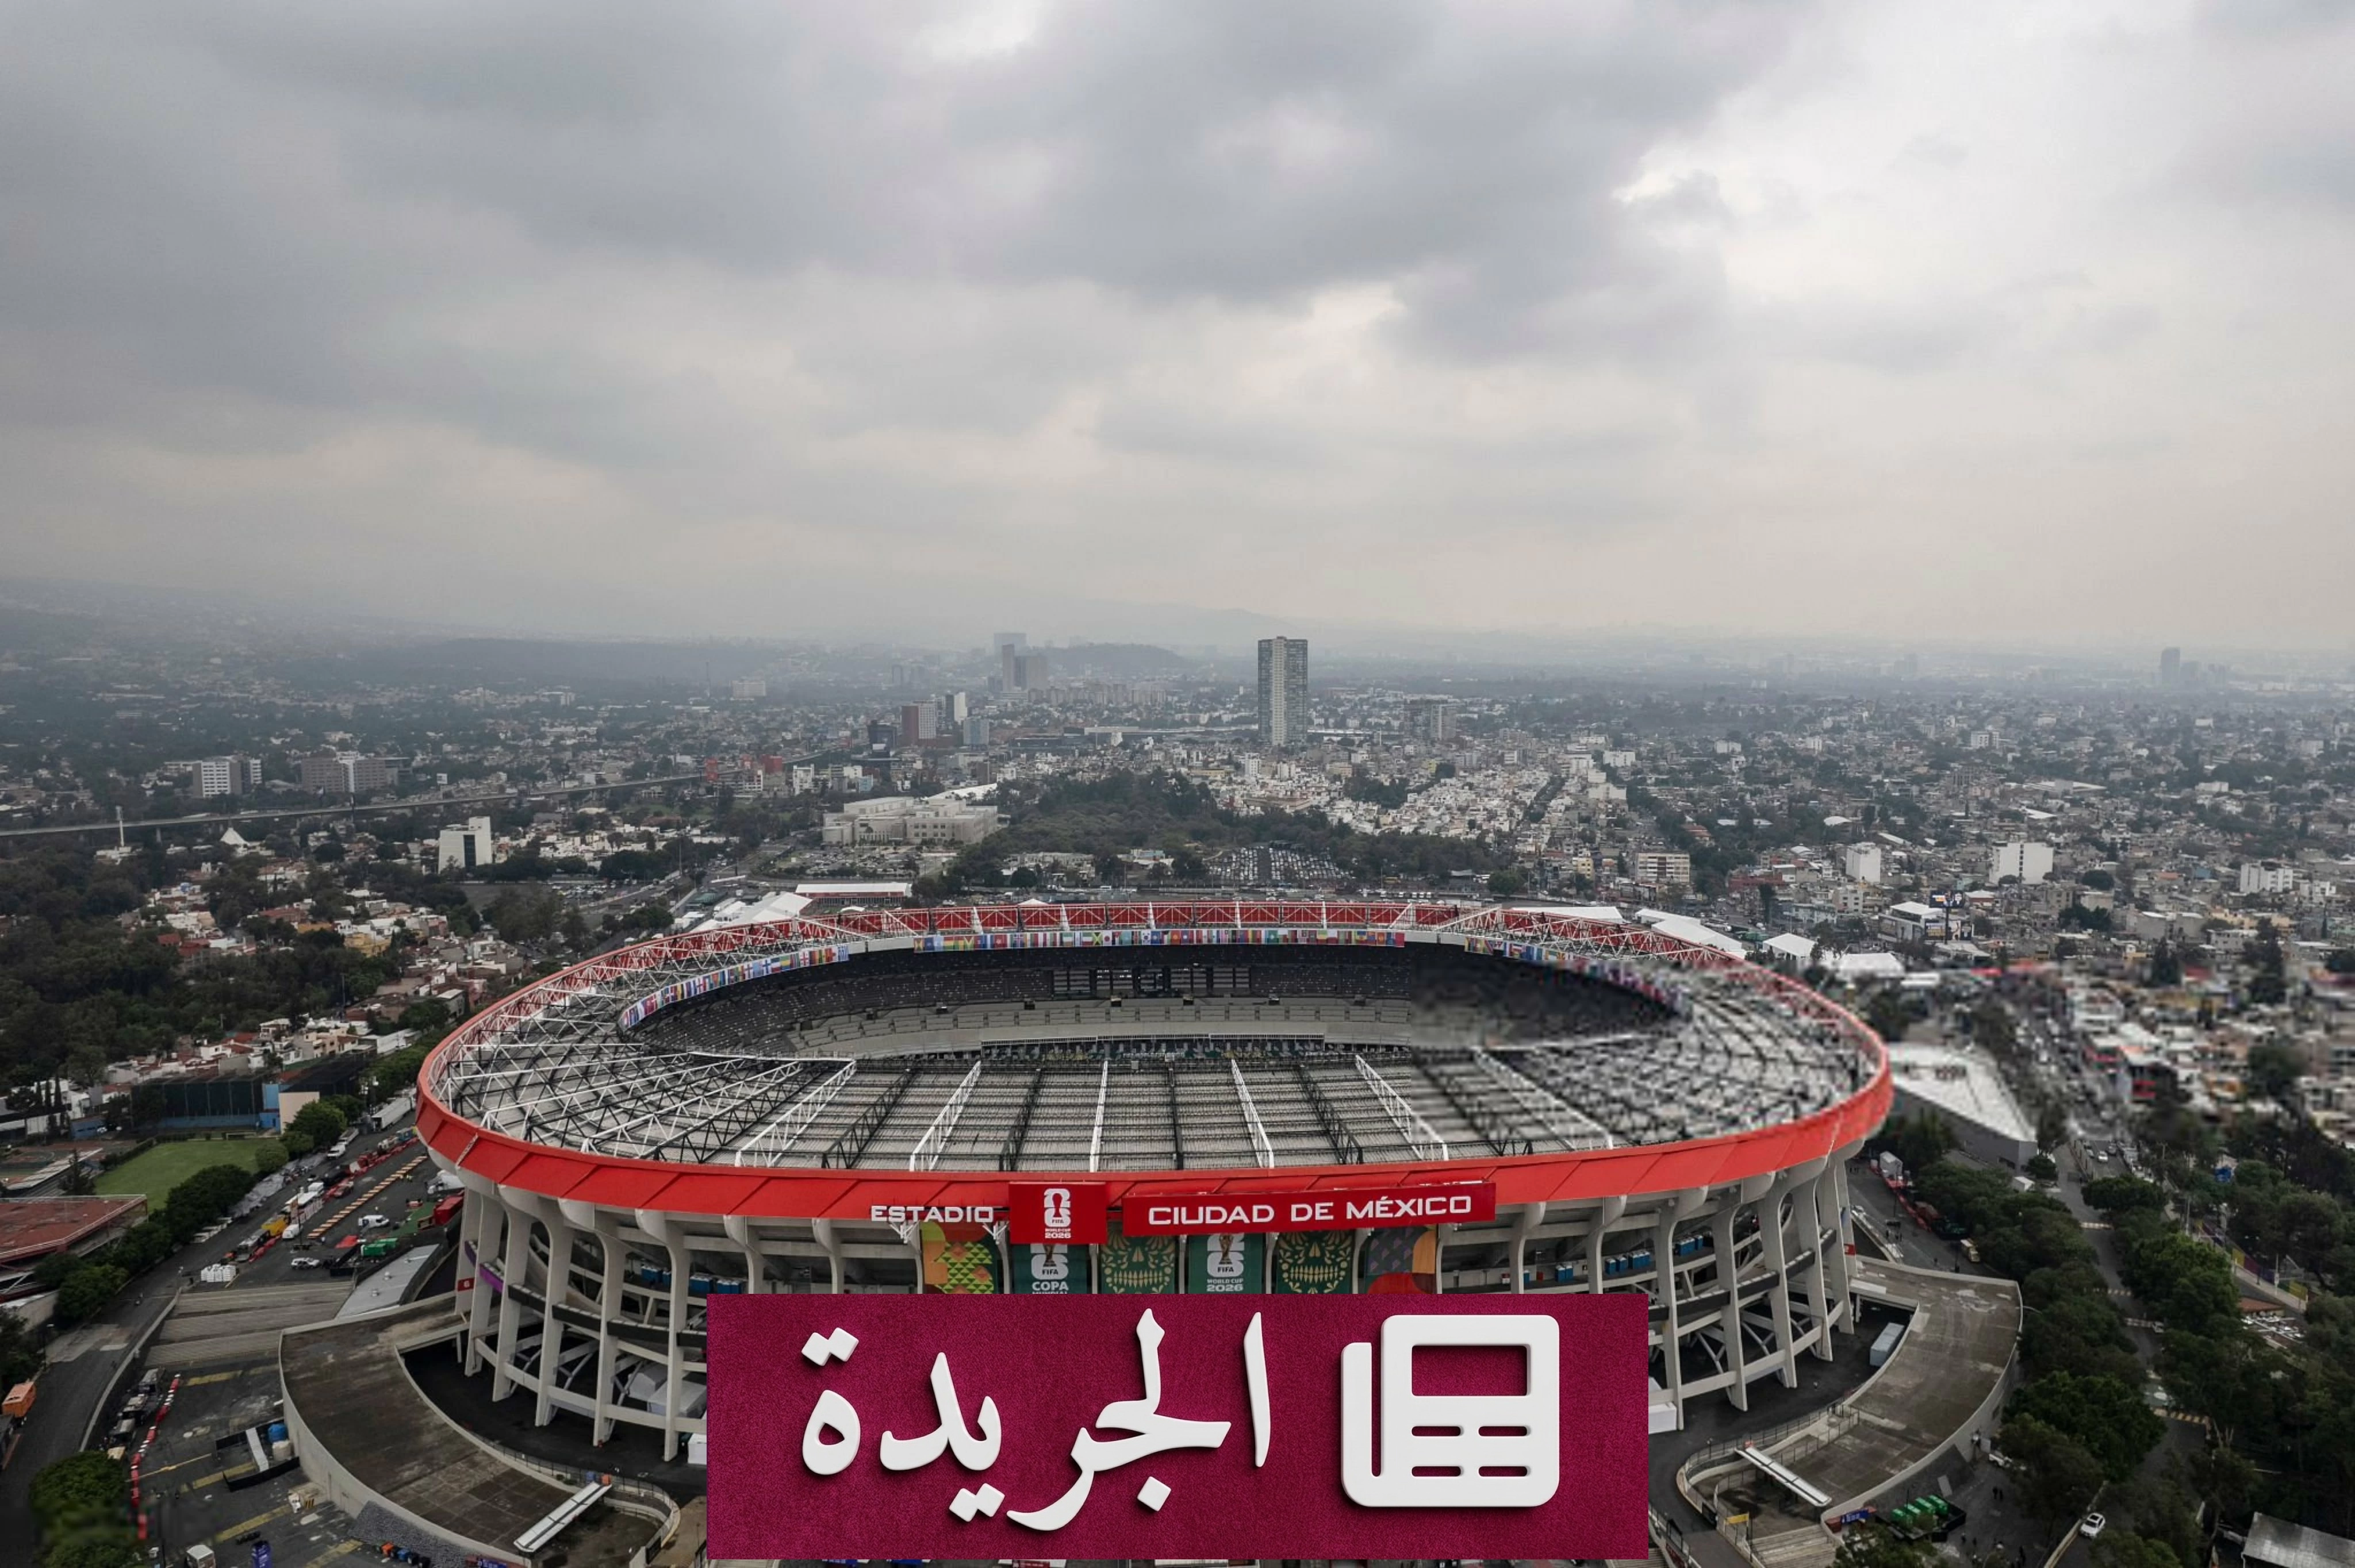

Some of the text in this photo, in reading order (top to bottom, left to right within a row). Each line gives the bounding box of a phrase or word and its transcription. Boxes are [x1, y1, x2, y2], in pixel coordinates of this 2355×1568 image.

[871, 1205, 994, 1223] ESTADIO
[1149, 1196, 1471, 1225] CIUDAD DE MÉXICO
[1032, 1281, 1069, 1290] COPA
[1207, 1284, 1244, 1292] 2026
